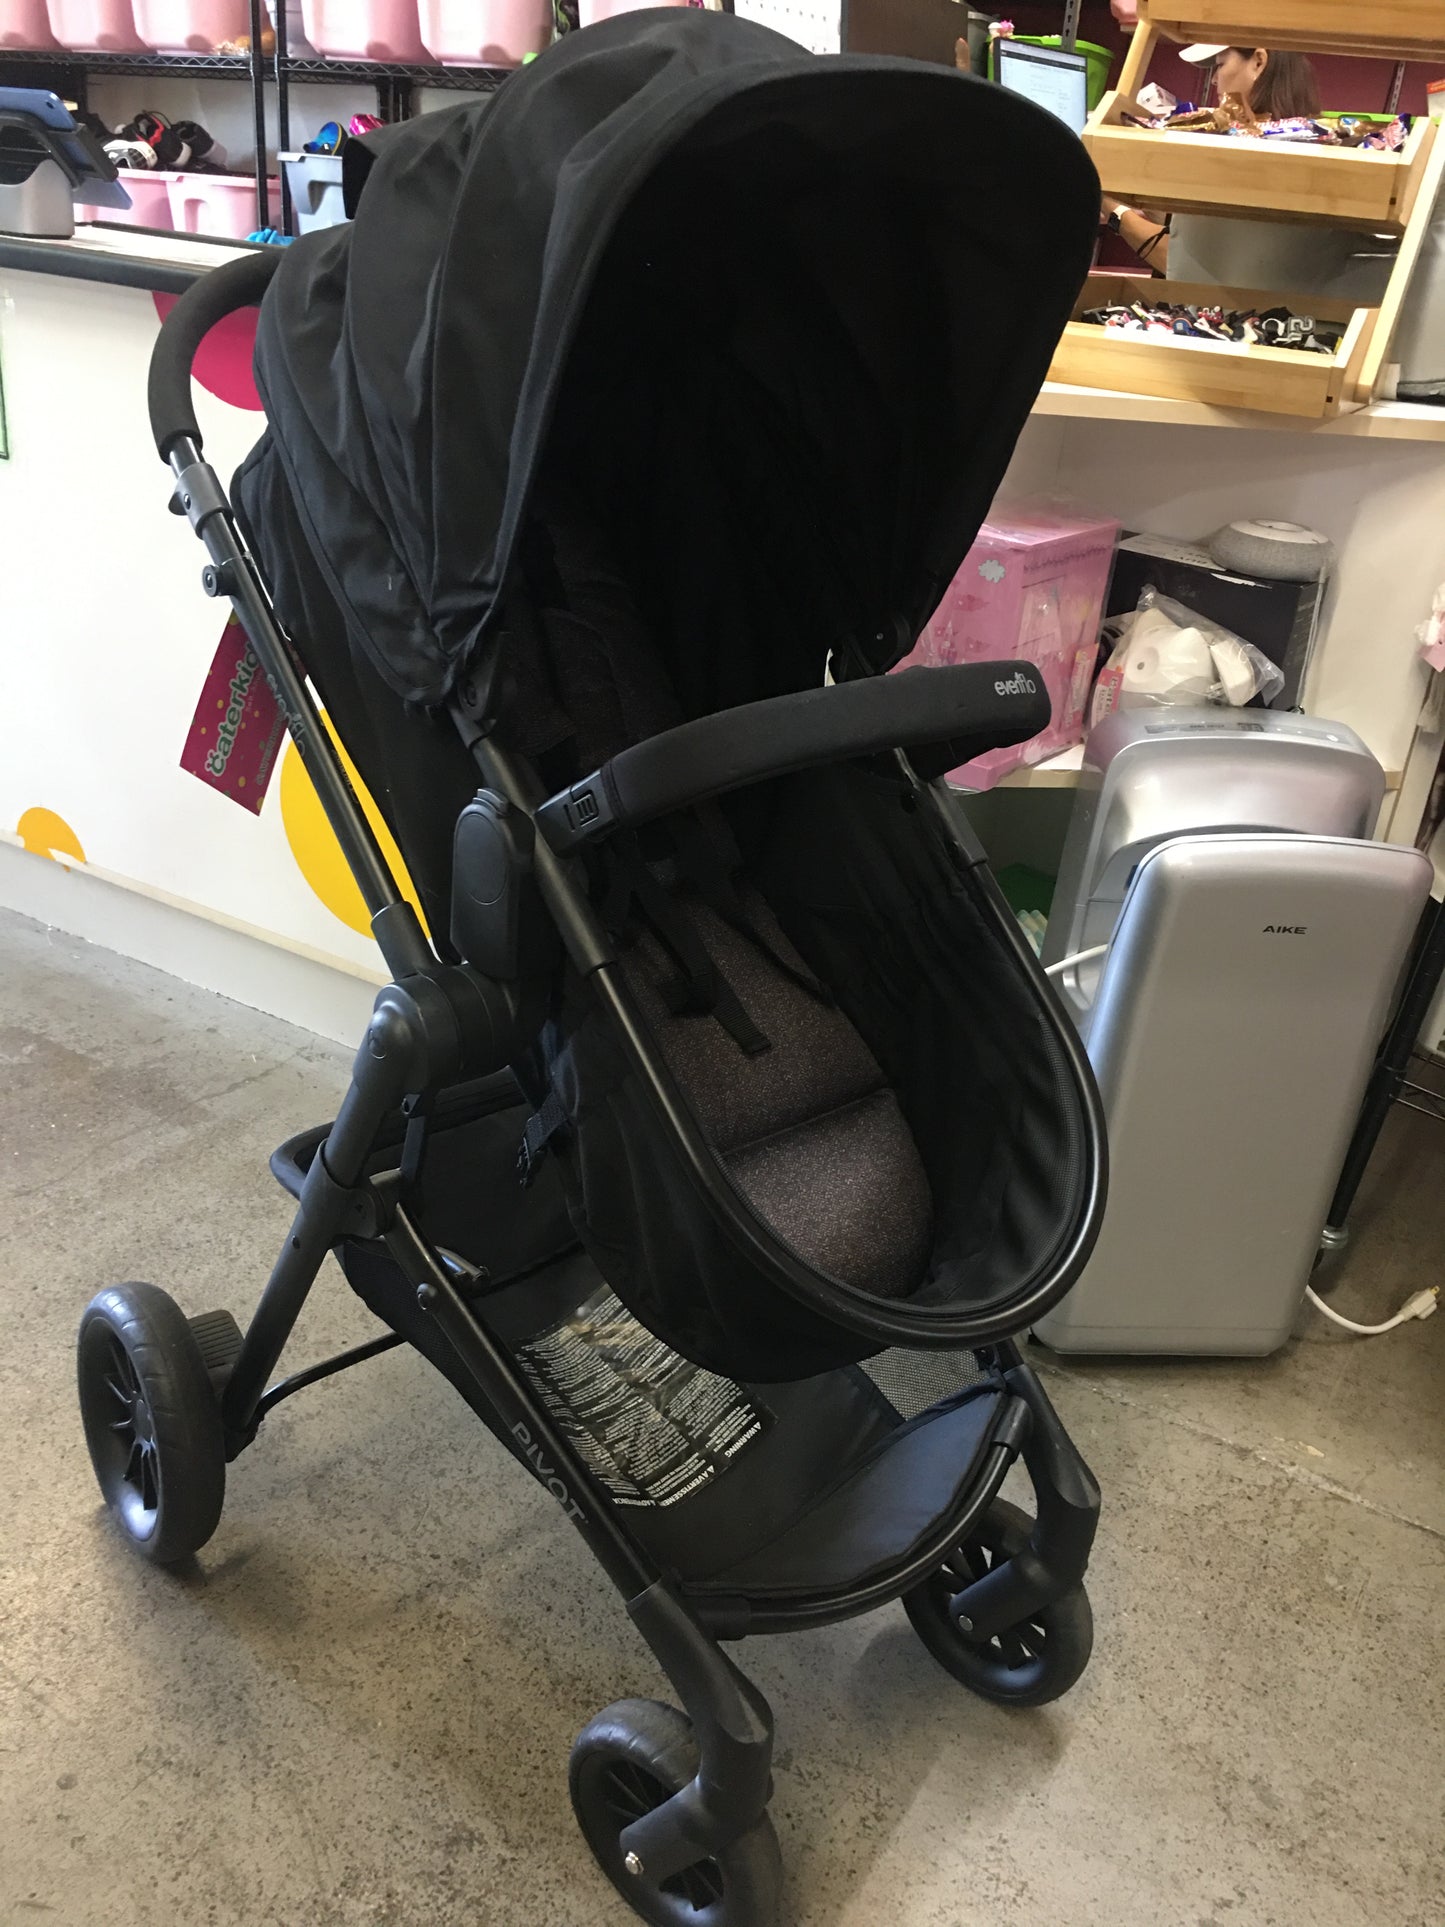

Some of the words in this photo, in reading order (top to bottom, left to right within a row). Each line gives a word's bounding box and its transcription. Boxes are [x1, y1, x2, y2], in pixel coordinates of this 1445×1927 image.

[994, 671, 1037, 696] evenflo
[1262, 925, 1308, 935] AIKE
[724, 1426, 758, 1458] WARNING
[511, 1421, 586, 1520] PIVOT
